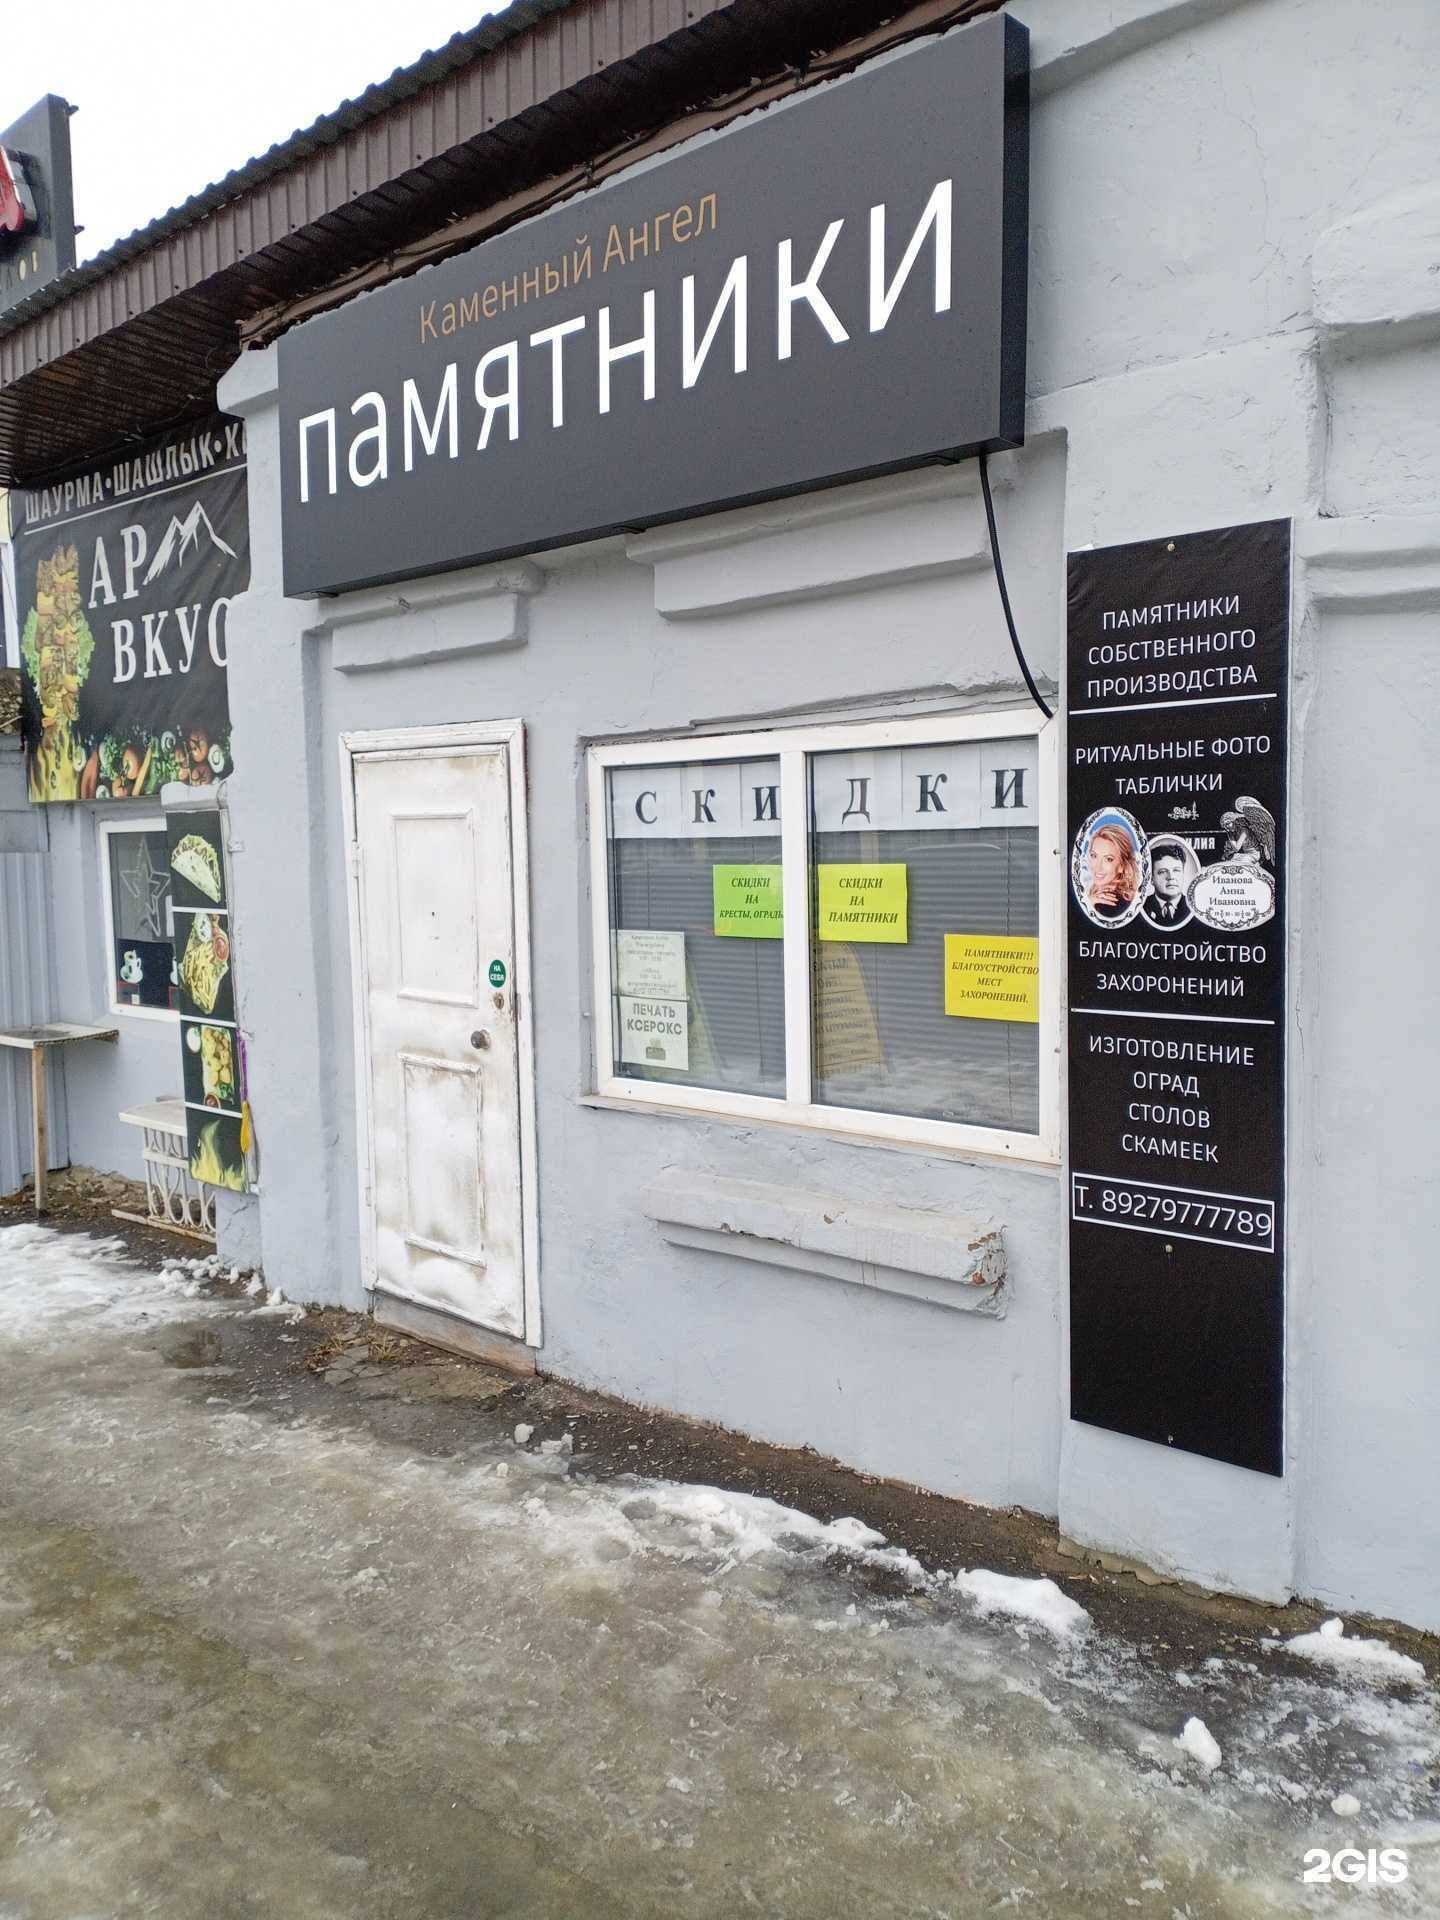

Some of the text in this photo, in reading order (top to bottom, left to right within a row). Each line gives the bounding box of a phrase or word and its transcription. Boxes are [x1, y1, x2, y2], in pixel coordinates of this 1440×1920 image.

[418, 193, 717, 344] Каменный Ангел
[298, 178, 953, 503] памятники
[25, 471, 104, 525] ШАУРМА
[113, 431, 215, 497] ШАШЛЫК
[1103, 595, 1241, 631] ПАМЯТНИКИ
[1088, 628, 1257, 665] СОБСТВЕННОГО
[1087, 664, 1259, 699] ПРОИЗВОДСТВА
[1075, 733, 1272, 765] РИТУАЛЬНЫЕ ФОТО
[1115, 773, 1223, 796] ТАБЛИЧКИ
[731, 877, 771, 889] СКИДКИ
[839, 878, 883, 889] СКИДКИ
[1212, 875, 1253, 885] Иванова
[1219, 886, 1246, 896] Анна
[744, 894, 760, 905] НА
[850, 895, 865, 907] НА
[1209, 897, 1257, 906] Ивановна
[828, 911, 898, 924] ПАМЯТНИКИ
[964, 948, 1034, 961] ПАМЯТНИКИ!!!
[1079, 940, 1267, 964] БЛАГОУСТРОЙСТВО
[951, 961, 1039, 976] БЛАГОУСТРОЙСТВО
[976, 977, 1002, 988] МЕСТ
[1096, 973, 1245, 997] ЗАХОРОНЕНИЙ
[632, 1002, 676, 1019] ПЕЧАТЬ
[626, 1017, 683, 1036] КСЕРОКС
[1089, 1035, 1255, 1067] ИЗГОТОВЛЕНИЕ
[1133, 1071, 1200, 1099] ОГРАД
[1128, 1102, 1211, 1129] СТОЛОВ
[1121, 1134, 1219, 1164] СКАМЕЕК
[1075, 1185, 1273, 1237] Т. 89279777789
